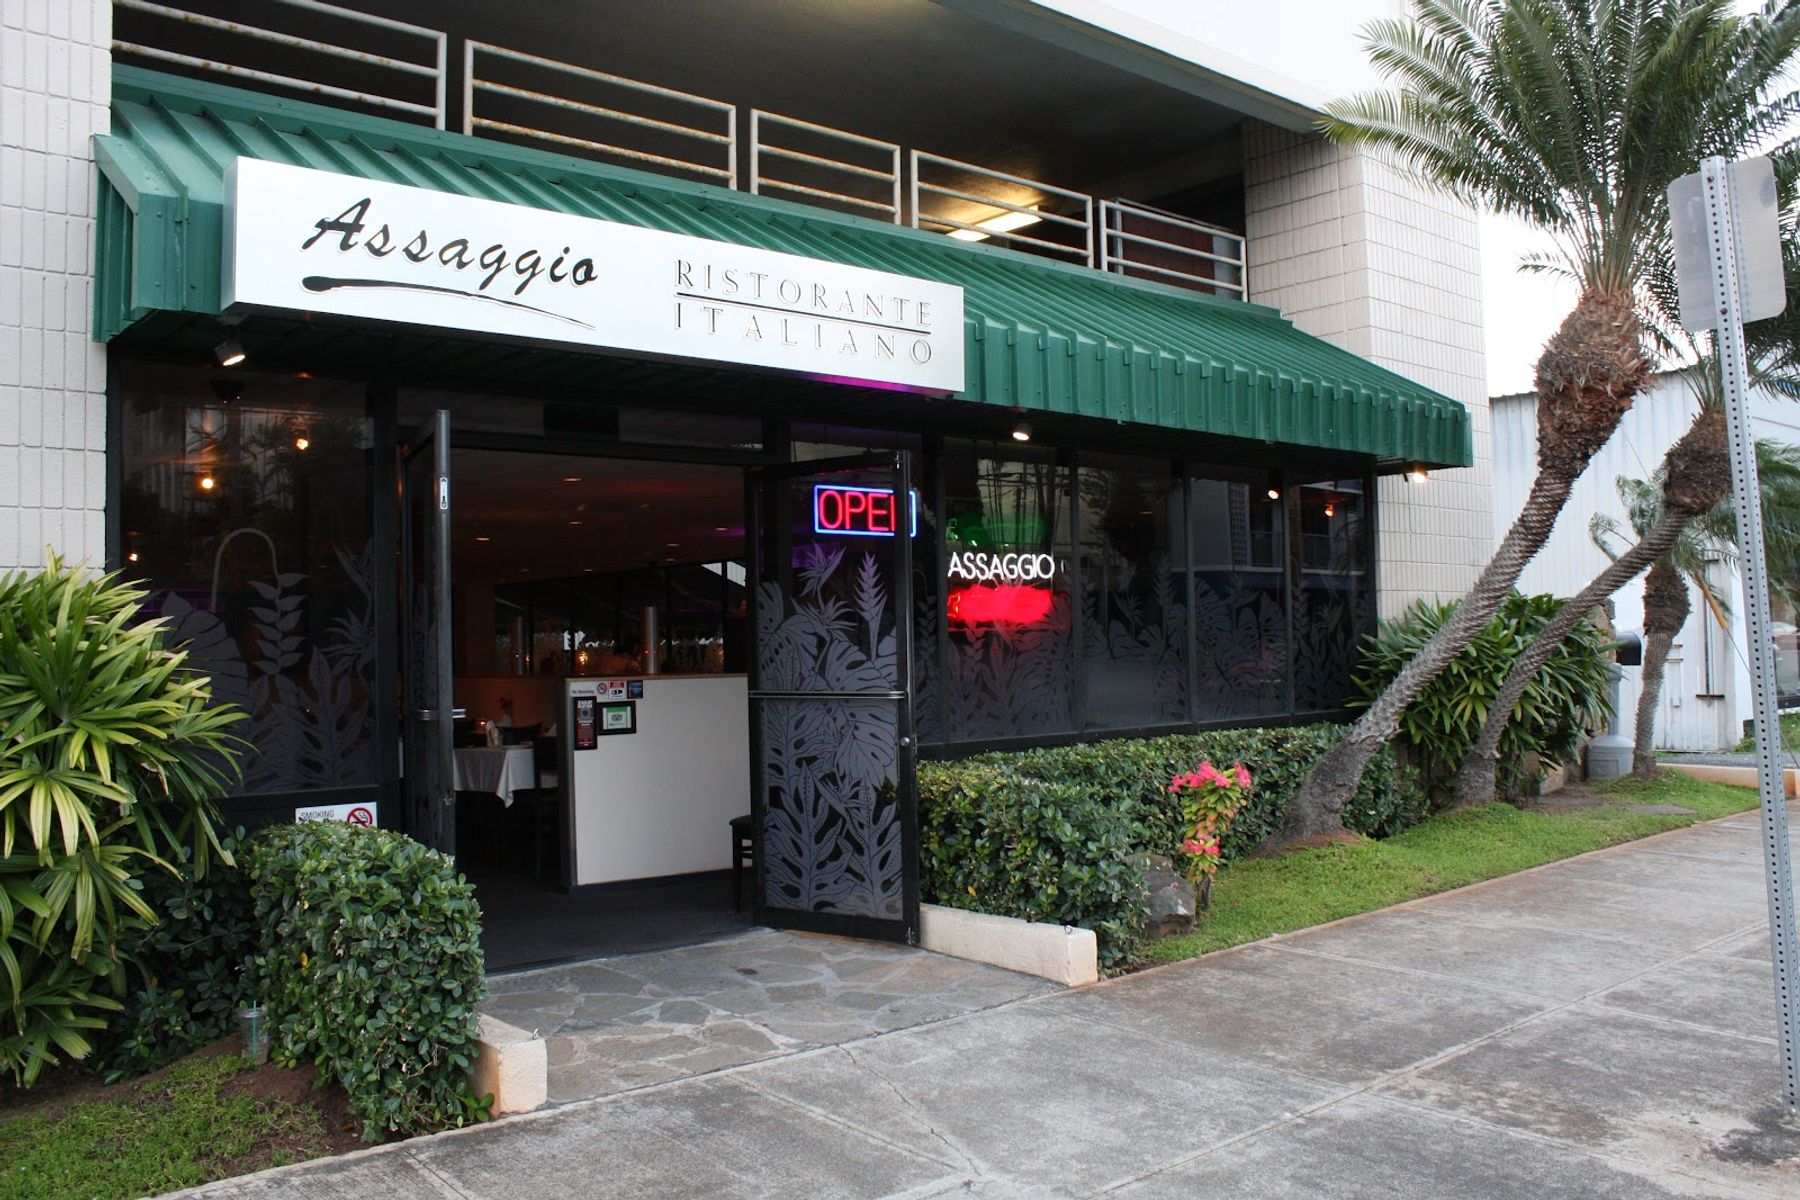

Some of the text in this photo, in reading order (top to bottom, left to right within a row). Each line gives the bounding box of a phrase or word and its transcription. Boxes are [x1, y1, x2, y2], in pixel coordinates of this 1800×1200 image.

[302, 197, 599, 296] Assaggio
[675, 260, 932, 327] RISTORANTE
[675, 301, 933, 366] ITALIANO
[947, 551, 1056, 580] ASSAGGIO
[300, 810, 335, 821] SMOKING
